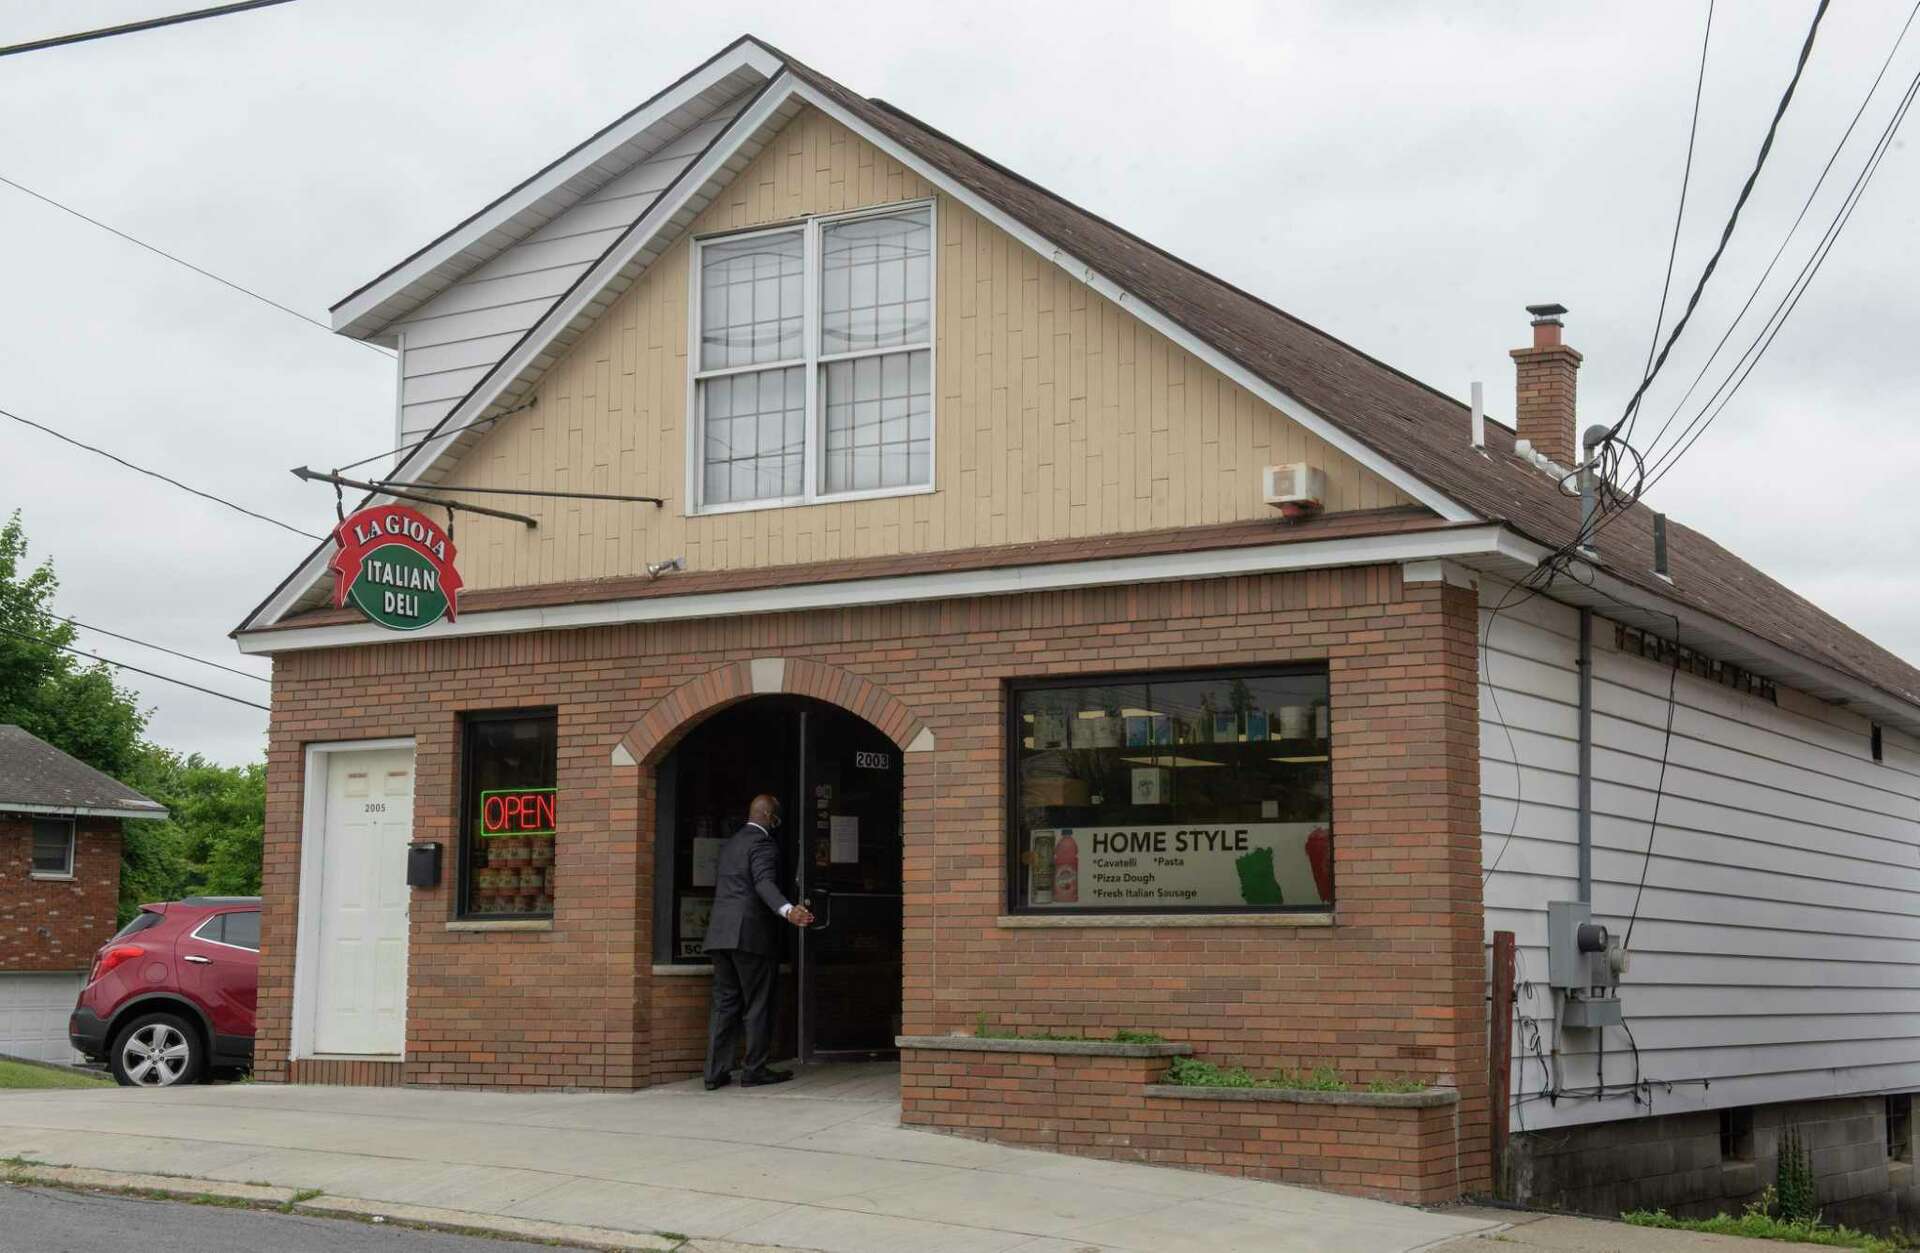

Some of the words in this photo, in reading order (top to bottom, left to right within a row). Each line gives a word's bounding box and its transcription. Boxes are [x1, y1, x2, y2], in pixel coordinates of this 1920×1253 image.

[368, 560, 434, 591] ITALIAN
[384, 591, 418, 616] DELI
[858, 753, 888, 768] 2003
[365, 803, 386, 812] 2005
[484, 795, 555, 830] OPEN
[1093, 831, 1167, 853] HOME
[1175, 829, 1249, 851] STYLE
[1123, 872, 1155, 884] Dough
[1125, 888, 1154, 898] Italian
[1157, 888, 1198, 899] Sausage
